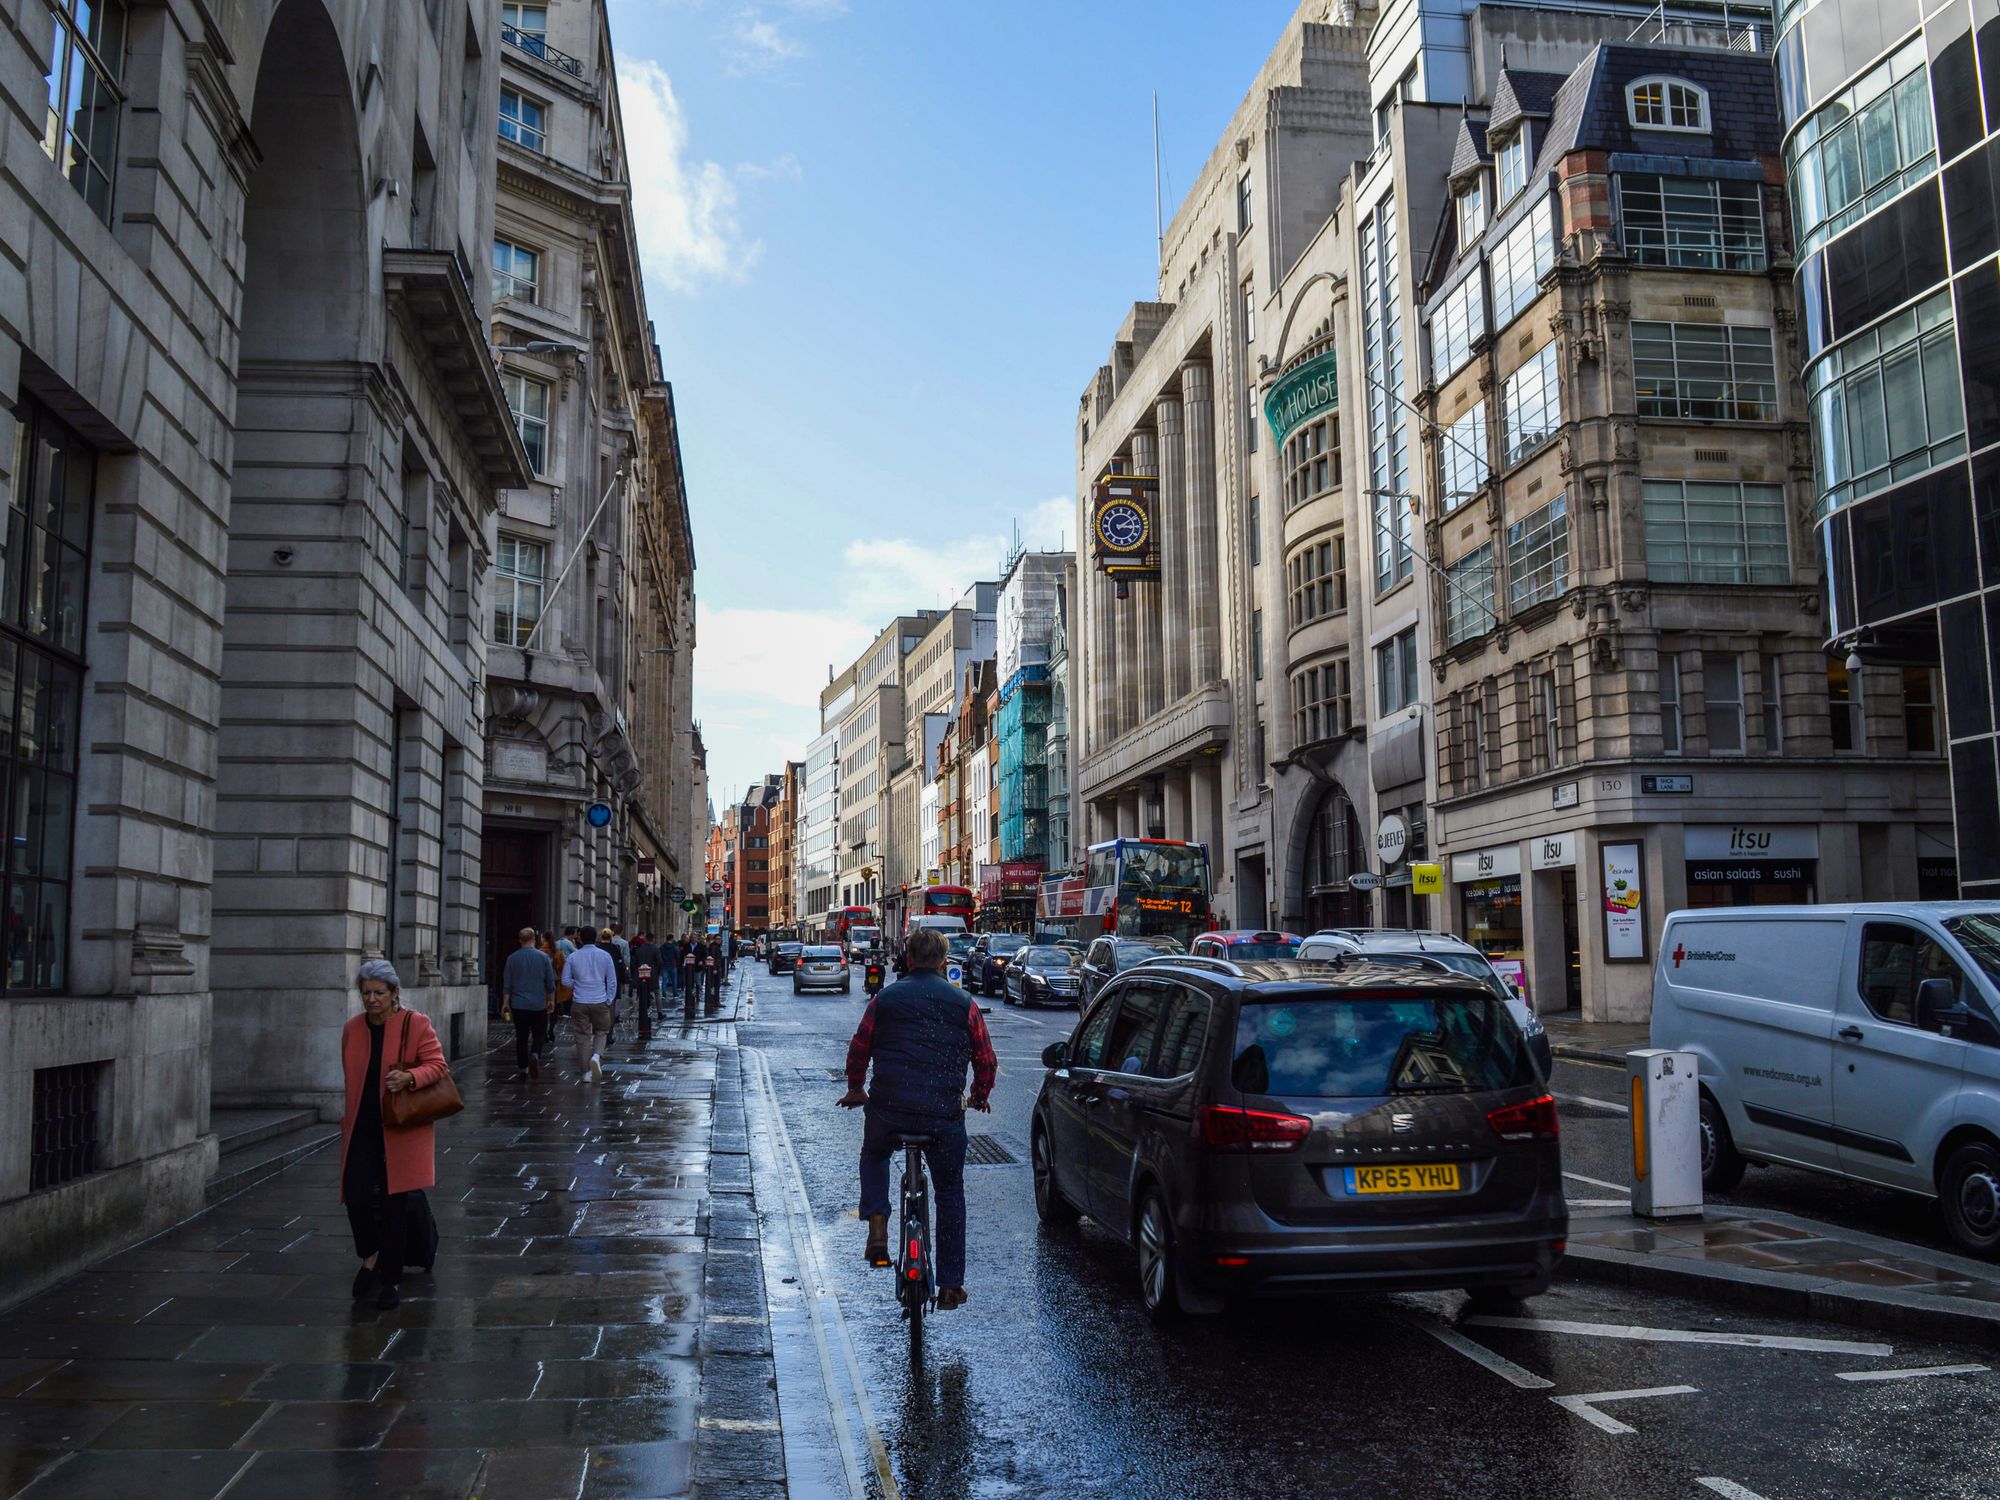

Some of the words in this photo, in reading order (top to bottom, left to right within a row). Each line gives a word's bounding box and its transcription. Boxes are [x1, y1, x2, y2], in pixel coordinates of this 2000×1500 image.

[1287, 370, 1338, 423] HOUSE
[1601, 780, 1622, 791] 130
[1383, 830, 1404, 848] JEEVES
[1730, 827, 1771, 849] itsu
[1543, 839, 1561, 859] itsu
[1478, 851, 1493, 871] itsu
[1418, 873, 1437, 884] itsu
[1694, 868, 1723, 880] asian
[1726, 867, 1761, 880] salads
[1774, 867, 1801, 879] sushi
[1922, 866, 1938, 877] hot
[1180, 900, 1192, 913] T2
[1686, 951, 1736, 961] BritishRedCross
[1743, 1066, 1823, 1087] www.redcross.org.uk
[1358, 1168, 1411, 1189] KP65
[1415, 1166, 1454, 1187] YHU
